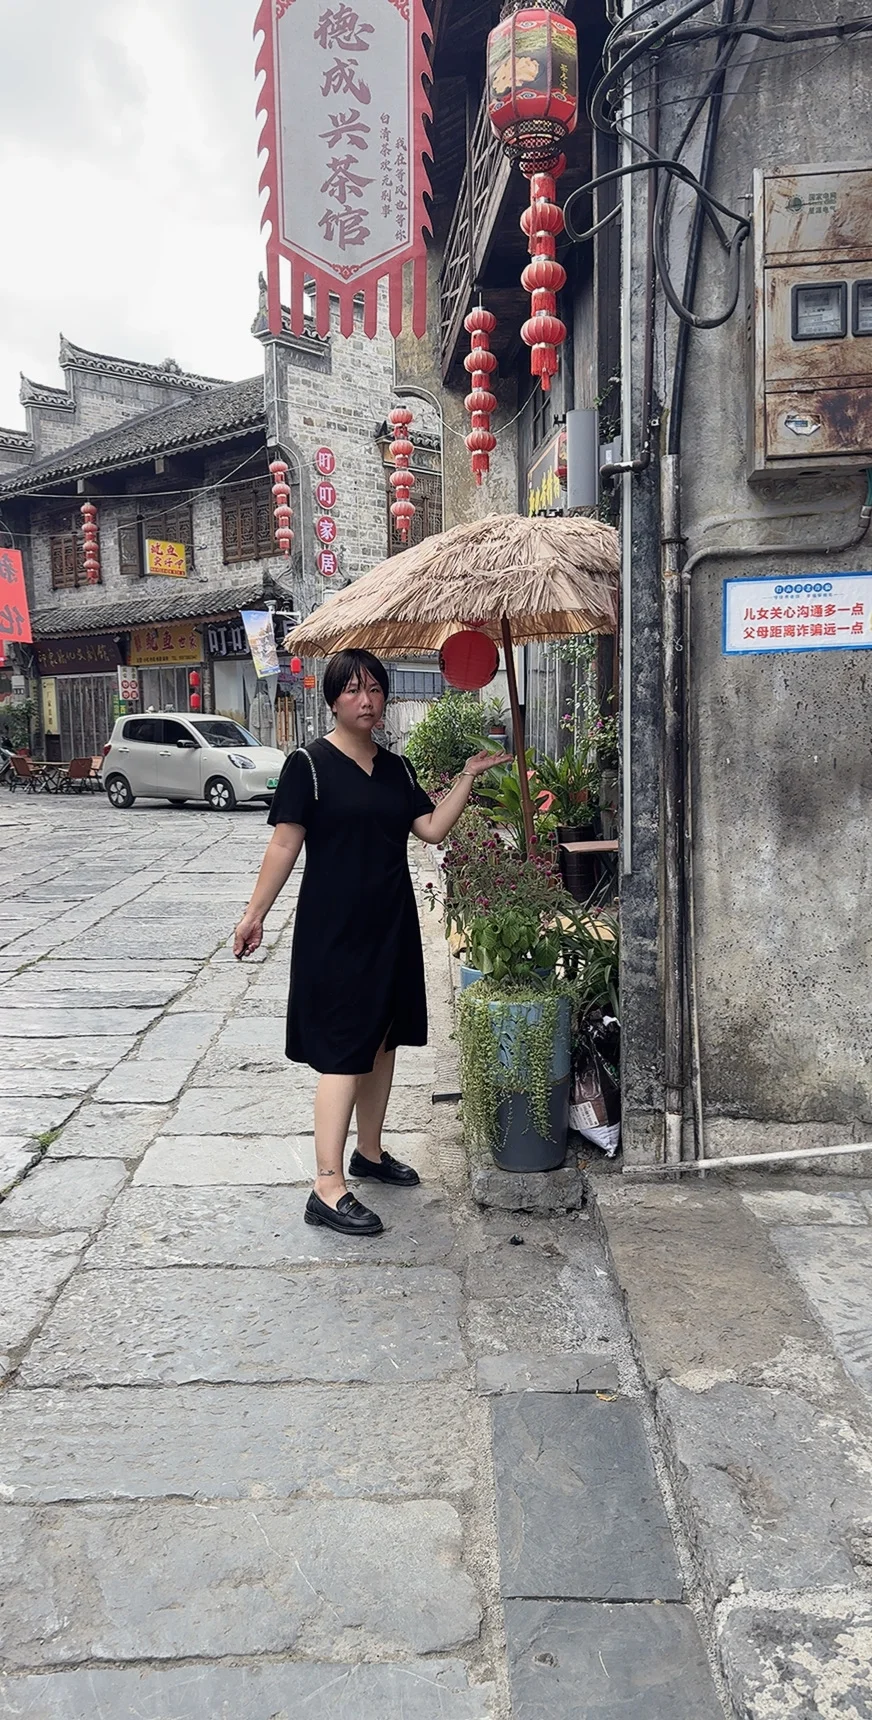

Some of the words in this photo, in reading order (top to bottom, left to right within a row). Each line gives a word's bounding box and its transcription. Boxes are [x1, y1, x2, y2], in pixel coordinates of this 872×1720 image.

[314, 3, 376, 251] 德成兴茶馆
[394, 137, 408, 241] 我在等风也等你
[317, 450, 335, 574] 叮叮家居
[743, 602, 864, 621] 儿女关心沟通多一点
[743, 621, 864, 640] 父母距离诈骗远一点
